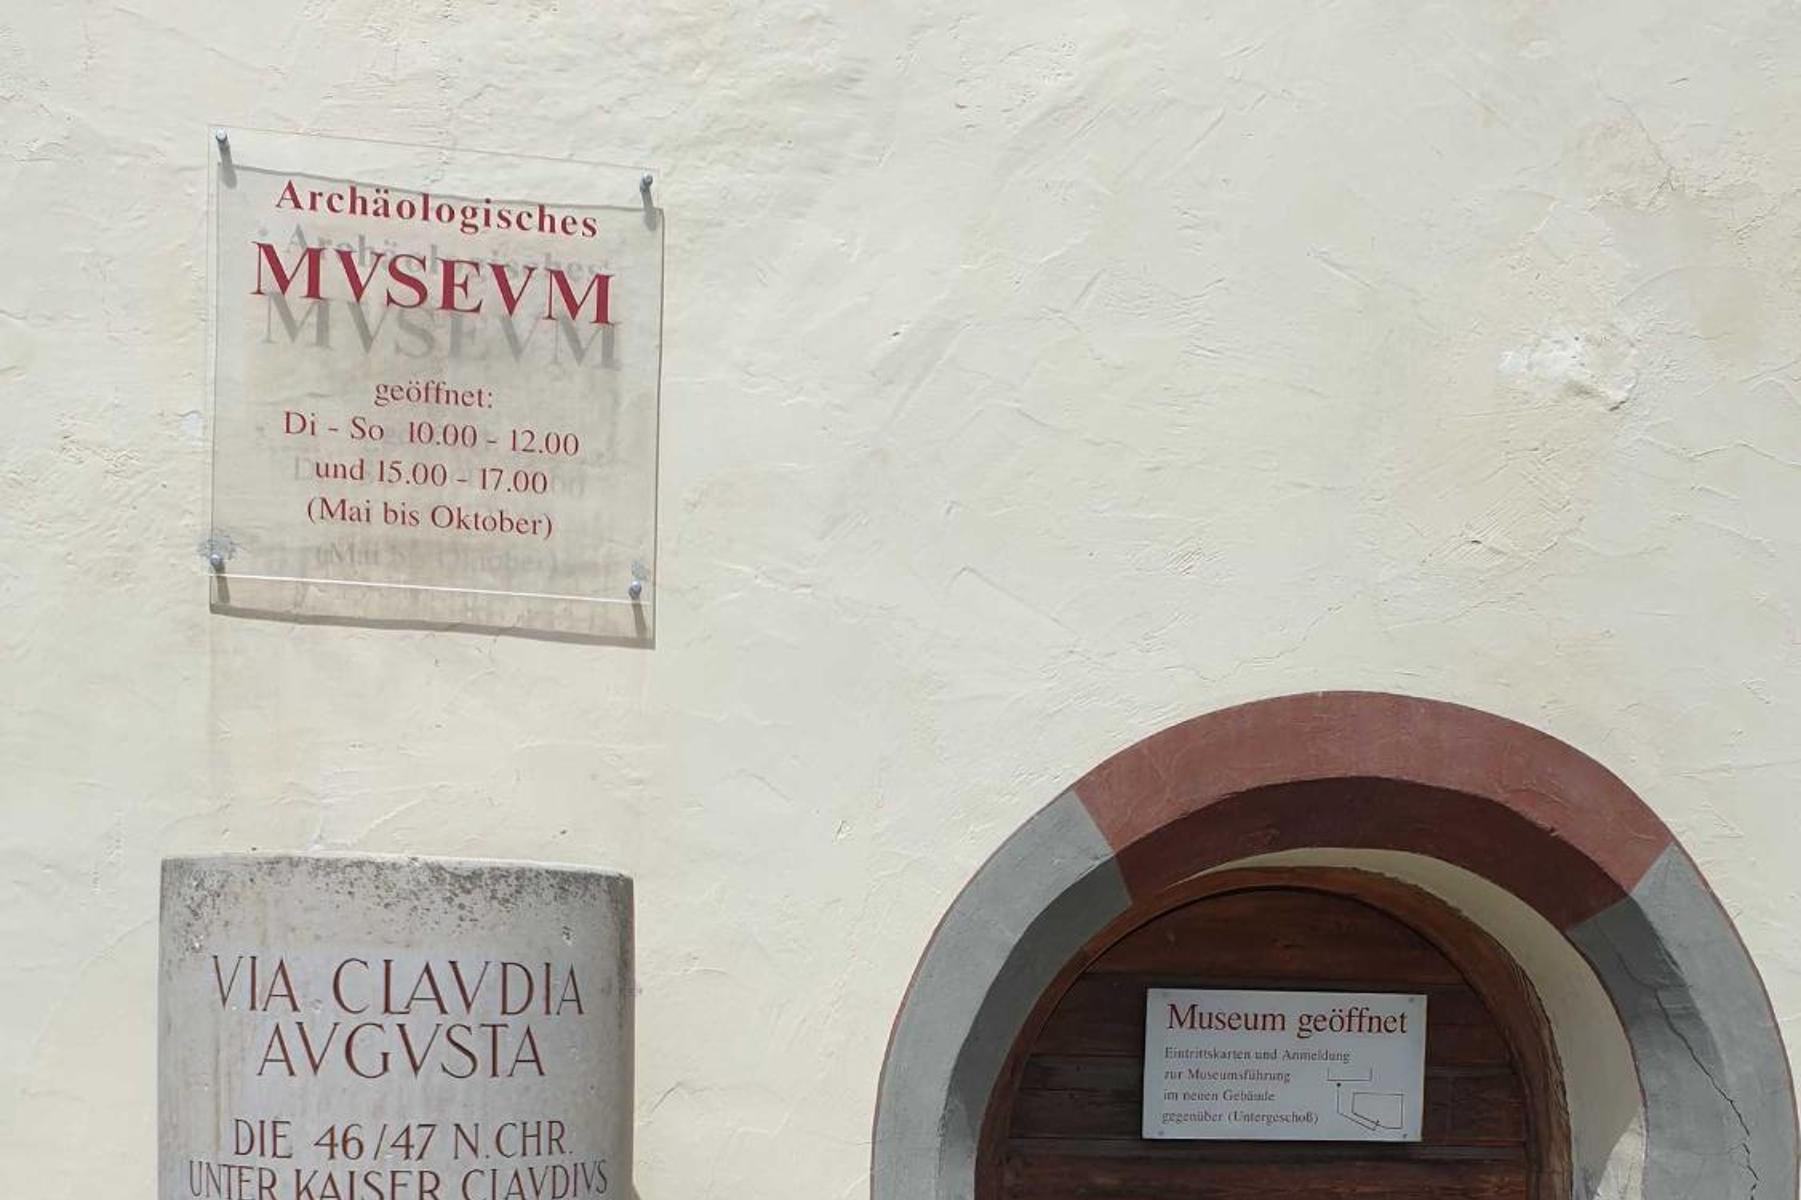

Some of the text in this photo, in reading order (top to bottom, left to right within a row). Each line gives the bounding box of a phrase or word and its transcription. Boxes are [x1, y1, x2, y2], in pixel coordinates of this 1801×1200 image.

[275, 180, 598, 237] Archäologisches
[250, 241, 619, 326] MVSEVM
[375, 380, 493, 410] geöffnet:
[283, 411, 318, 437] Di
[350, 417, 384, 442] So
[409, 420, 477, 449] 10.00
[511, 428, 579, 456] 12.00
[315, 460, 365, 483] und
[378, 460, 447, 487] 15.00
[480, 468, 548, 495] 17.00
[307, 497, 554, 540] (Mai bis Oktober)
[212, 954, 584, 1016] VIA CLAVDIA
[1167, 1003, 1407, 1039] Museum geöffnet
[256, 1021, 545, 1079] AVGVSTA
[1164, 1046, 1350, 1063] Eintrittskarten und Anmeldung
[1163, 1089, 1276, 1101] im neuen Gebäude
[1164, 1068, 1291, 1083] zur Museumsführung
[1161, 1110, 1319, 1125] gegenüber (Untergeschoß)
[234, 1118, 293, 1159] DIE
[314, 1123, 437, 1162] 46/47
